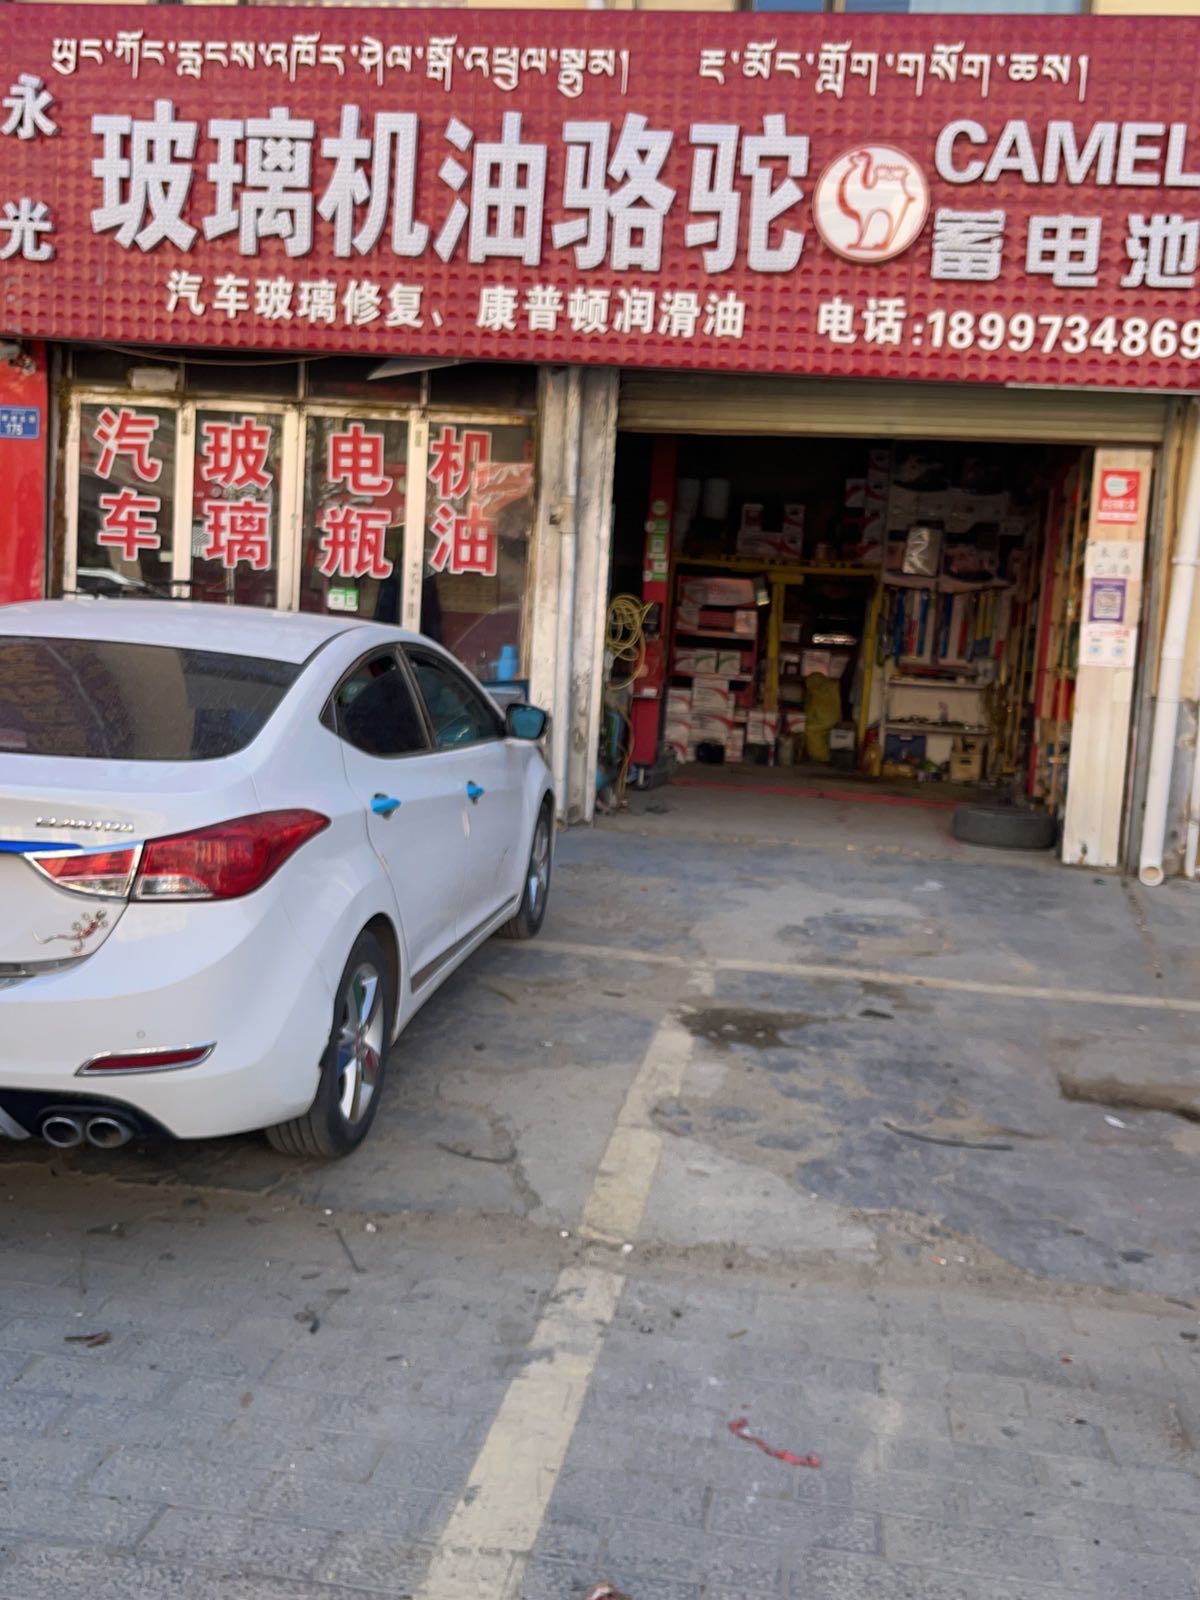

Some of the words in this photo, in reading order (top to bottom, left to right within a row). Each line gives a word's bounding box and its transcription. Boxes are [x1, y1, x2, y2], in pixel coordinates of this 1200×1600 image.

[0, 72, 58, 262] 永光
[90, 99, 810, 274] 玻璃机油骆驼
[934, 119, 1200, 187] CAMEL
[930, 207, 1200, 289] 蓄电池
[94, 407, 163, 562] 汽车
[201, 416, 273, 572] 玻璃
[320, 423, 394, 580] 电瓶
[428, 425, 498, 576] 机油
